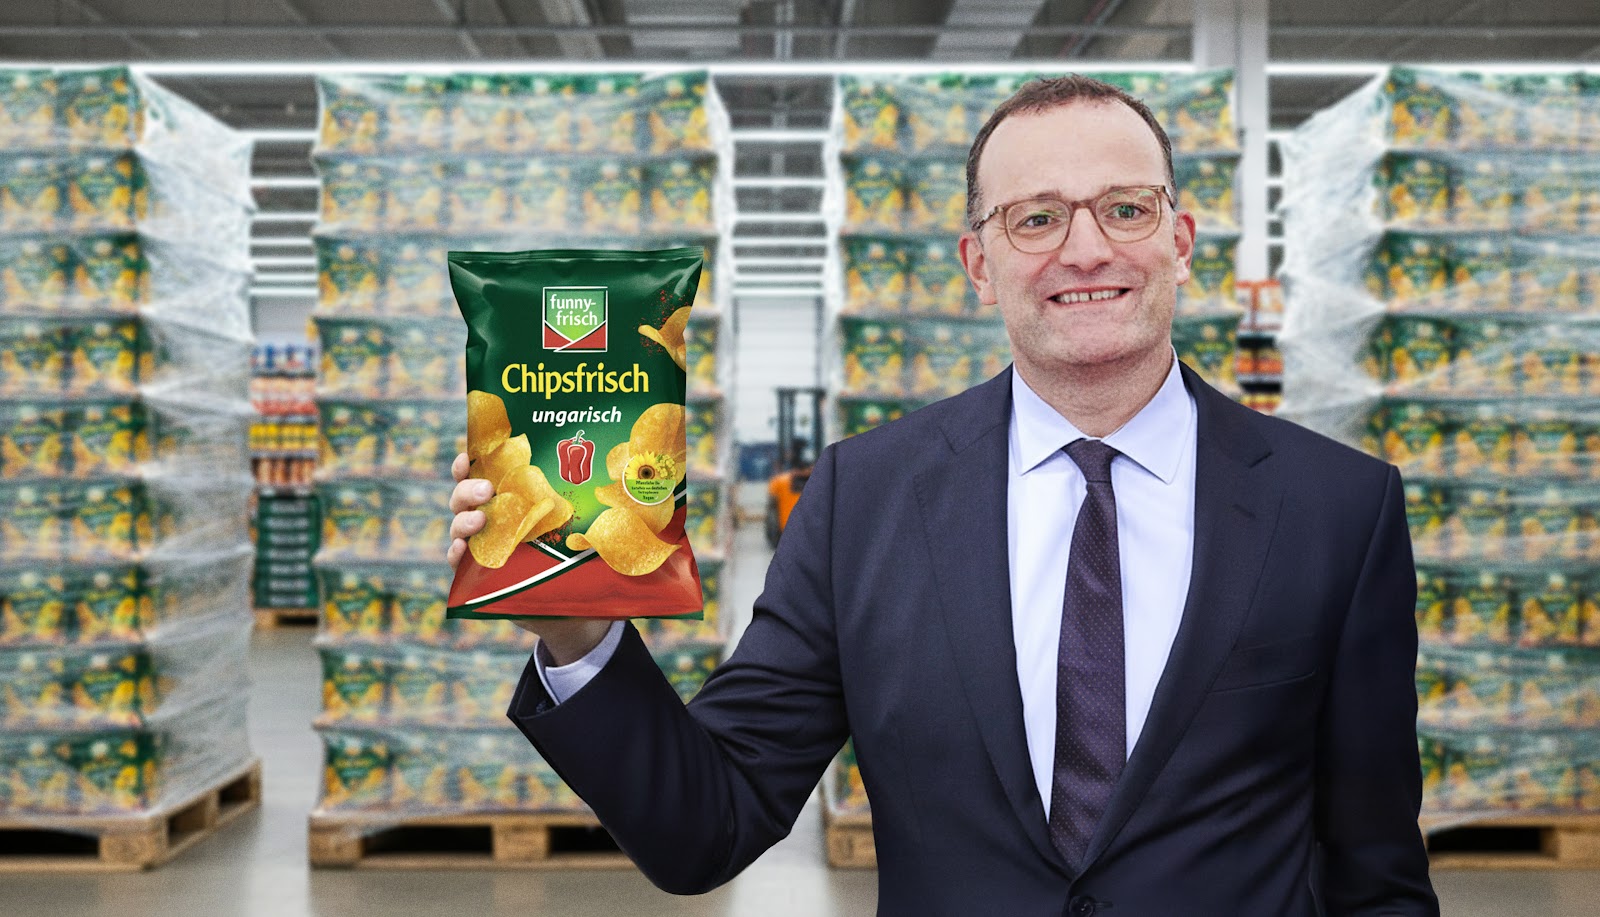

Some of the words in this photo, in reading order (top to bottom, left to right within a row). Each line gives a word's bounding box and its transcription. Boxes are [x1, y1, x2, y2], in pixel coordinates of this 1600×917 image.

[550, 294, 597, 312] funny-
[556, 310, 598, 326] frisch
[501, 362, 650, 400] Chipsfrisch
[532, 406, 622, 427] ungarisch
